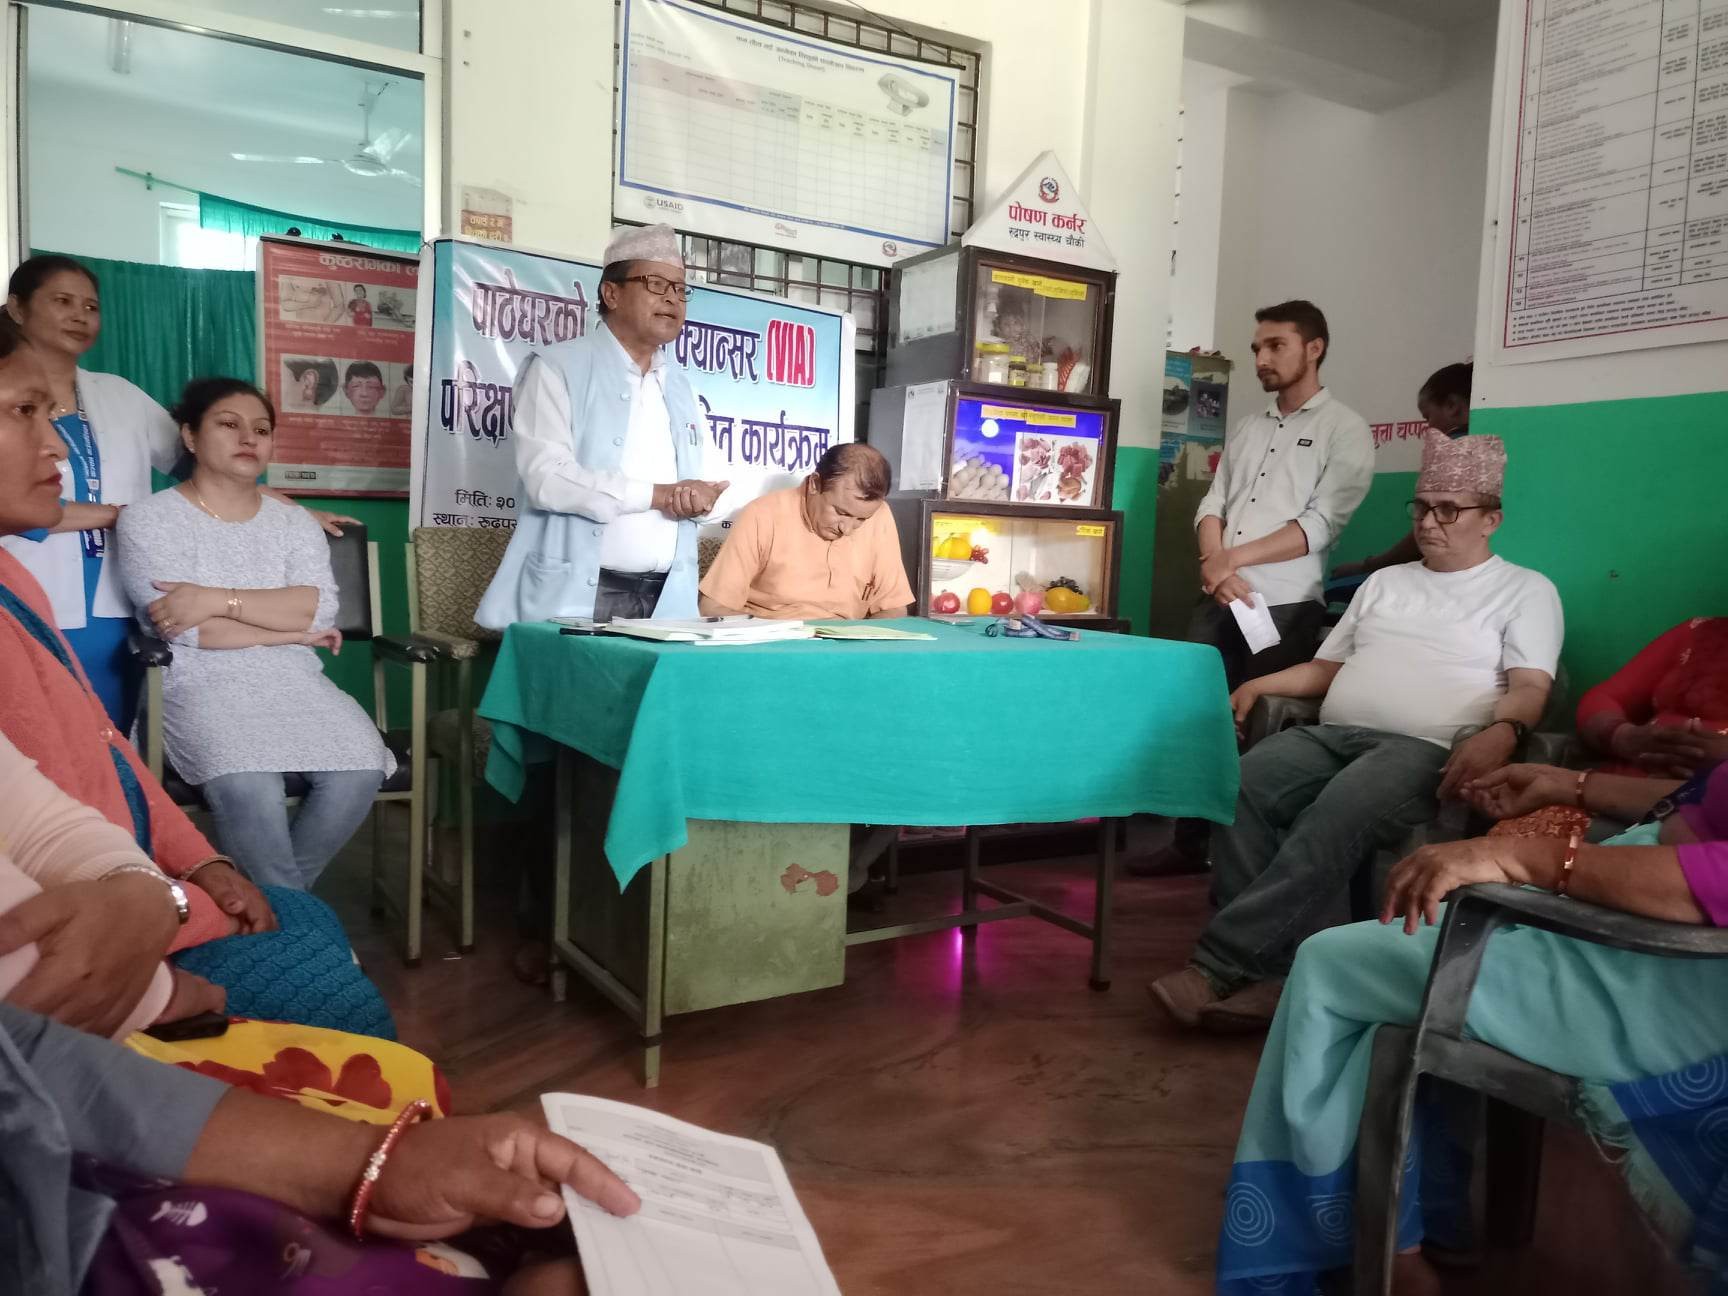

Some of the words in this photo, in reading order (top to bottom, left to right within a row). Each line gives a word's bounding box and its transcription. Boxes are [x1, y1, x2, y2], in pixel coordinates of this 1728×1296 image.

[656, 199, 684, 211] USAID
[1008, 201, 1048, 226] पोषण
[1052, 213, 1087, 234] कर्नर
[472, 267, 588, 346] पाठेघरको
[675, 320, 760, 381] क्यान्सर
[741, 410, 830, 472] कार्यक्रम
